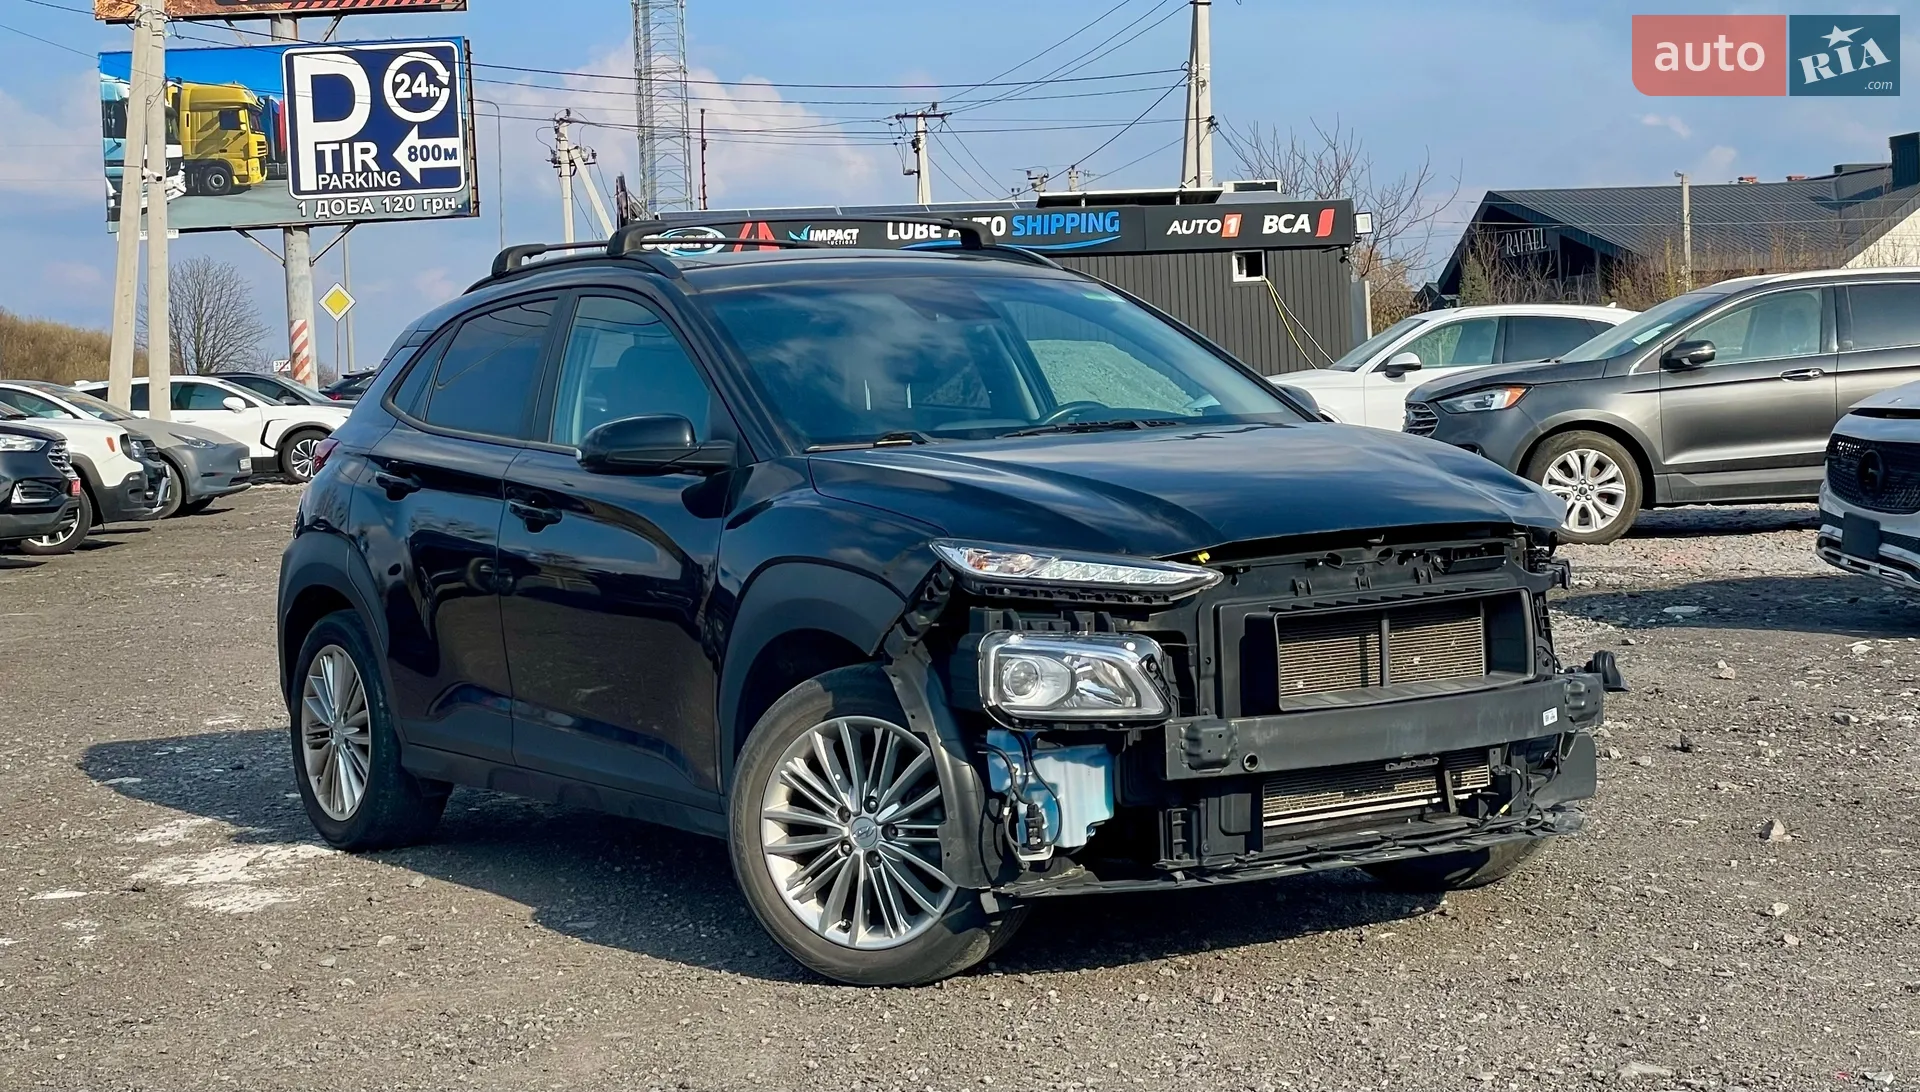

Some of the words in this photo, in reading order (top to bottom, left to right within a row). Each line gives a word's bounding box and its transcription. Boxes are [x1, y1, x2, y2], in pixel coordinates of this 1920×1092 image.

[394, 72, 441, 99] 24h
[292, 53, 372, 192] P
[316, 141, 381, 174] TIR
[318, 170, 402, 190] PARKING
[298, 201, 308, 217] 1
[314, 197, 376, 219] ДОБА
[382, 195, 416, 213] 120
[423, 196, 463, 214] грн.
[809, 228, 860, 242] IMPACT
[1011, 211, 1120, 236] SHIPPING
[1262, 213, 1312, 234] BCA
